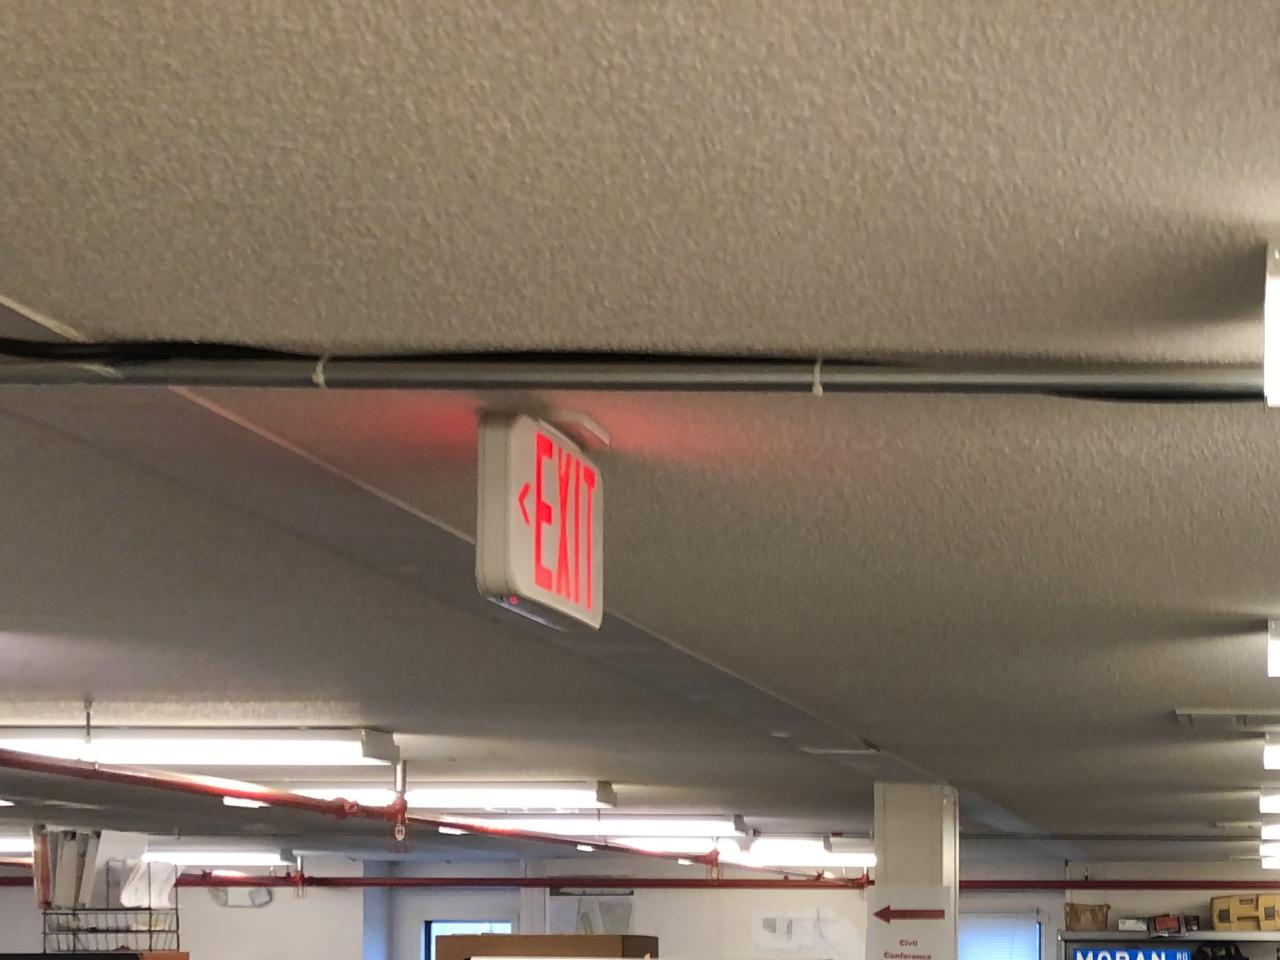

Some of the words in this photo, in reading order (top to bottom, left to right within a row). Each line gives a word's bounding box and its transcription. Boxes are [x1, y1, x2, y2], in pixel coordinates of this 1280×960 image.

[535, 432, 597, 612] EXIT
[899, 939, 918, 947] Civil
[883, 952, 932, 960] Conference
